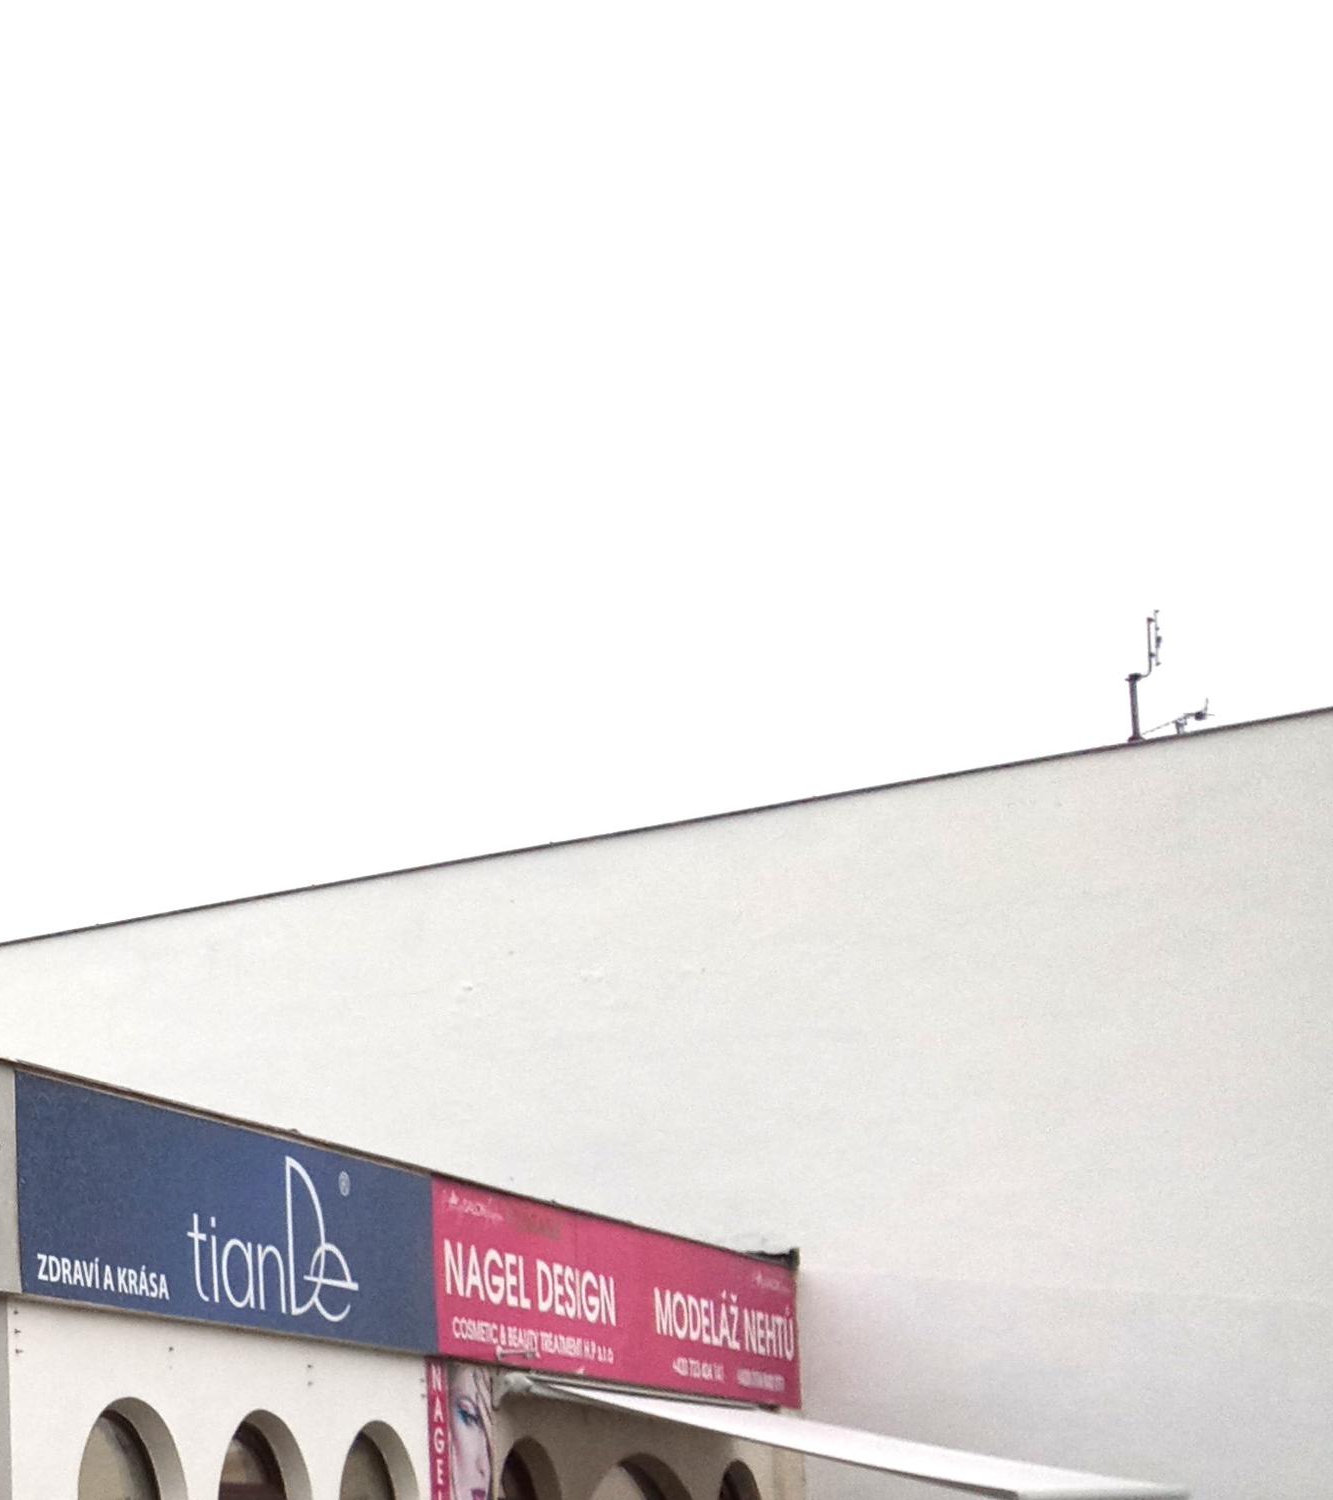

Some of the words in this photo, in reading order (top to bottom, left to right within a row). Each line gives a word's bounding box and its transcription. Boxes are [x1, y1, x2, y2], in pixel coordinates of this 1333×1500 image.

[36, 1252, 101, 1290] ZDRAVÍ
[102, 1267, 115, 1292] A
[116, 1263, 170, 1300] KRÁSA
[186, 1155, 359, 1322] tianDe
[443, 1238, 532, 1311] NAGEL
[536, 1258, 617, 1327] DESIGN
[653, 1287, 741, 1351] MODELÁŽ
[743, 1305, 795, 1362] NEHTŮ
